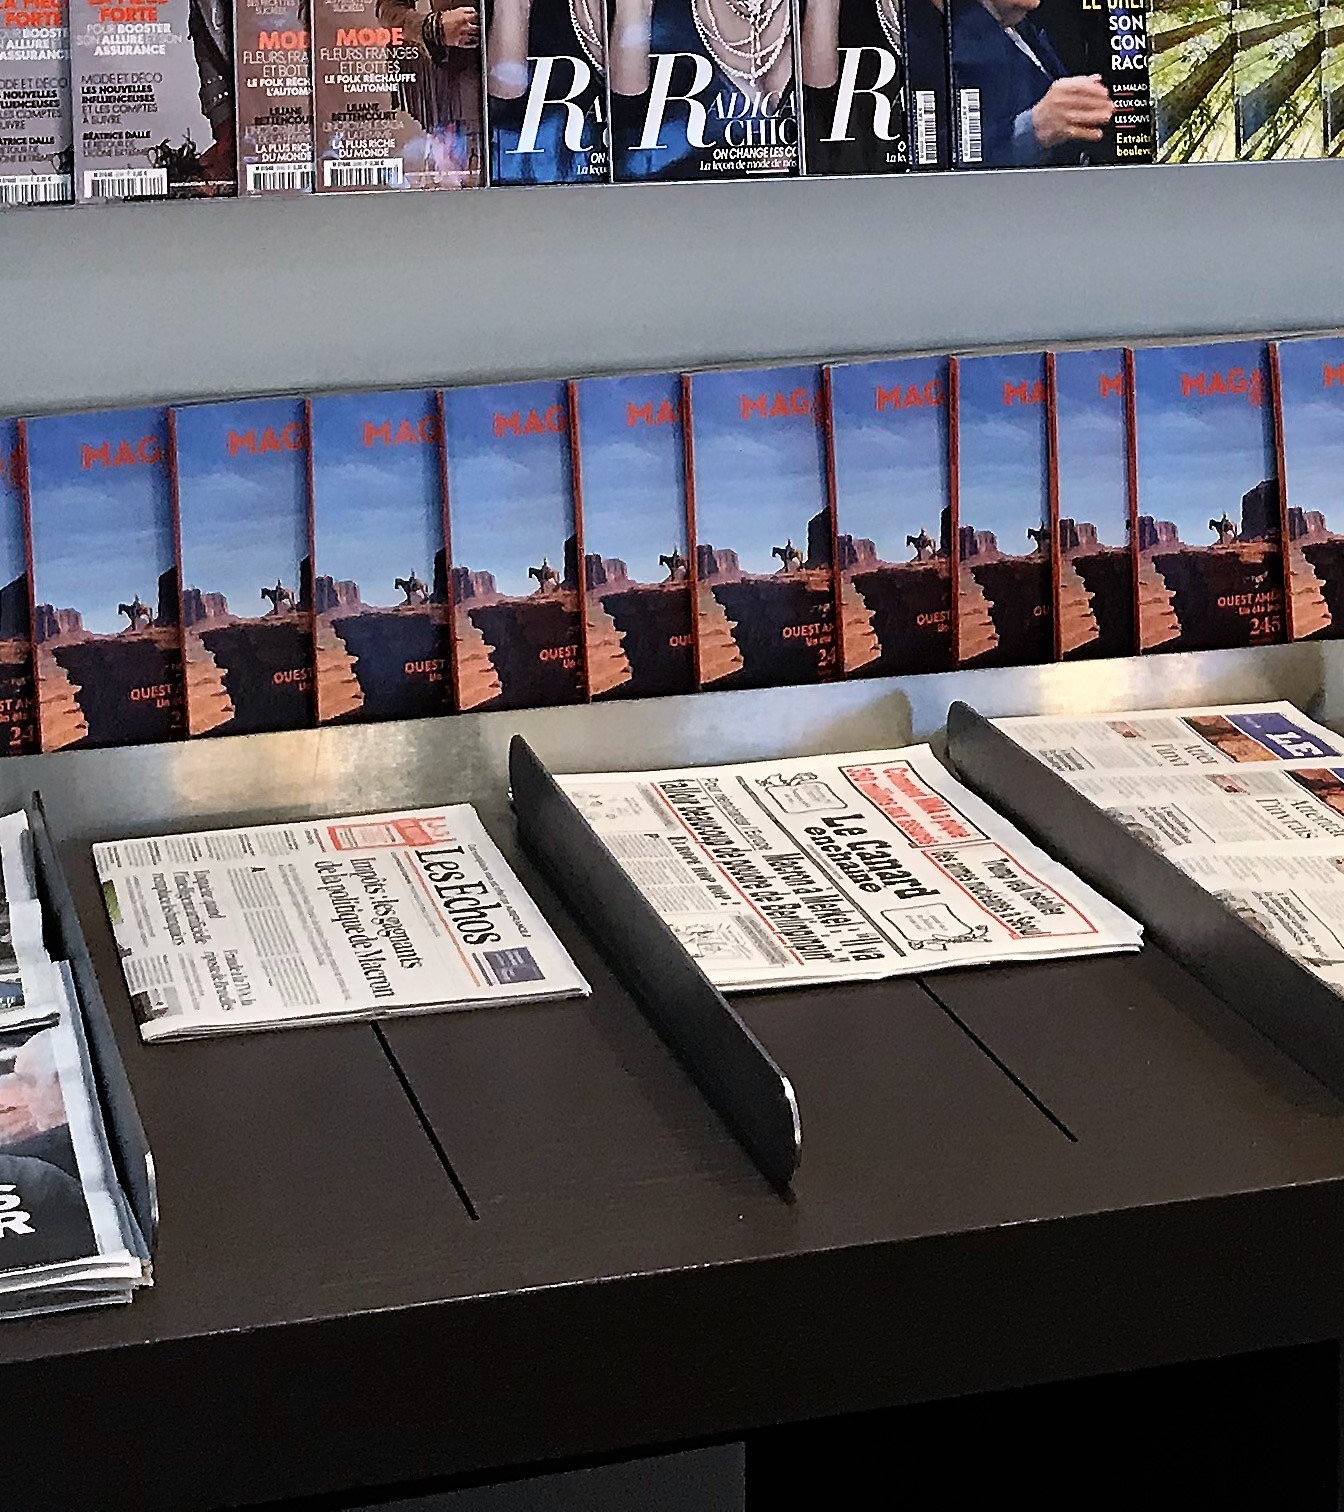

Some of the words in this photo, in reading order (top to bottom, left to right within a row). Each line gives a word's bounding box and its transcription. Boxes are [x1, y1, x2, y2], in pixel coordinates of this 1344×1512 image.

[1109, 15, 1143, 31] SON
[101, 34, 144, 45] ALLURE
[336, 27, 404, 46] MODE
[93, 44, 166, 56] ASSURANCE
[365, 46, 419, 60] FRANGES
[819, 813, 879, 837] Le
[413, 845, 480, 882] Les
[845, 839, 941, 899] Canard
[434, 881, 521, 945] Echos
